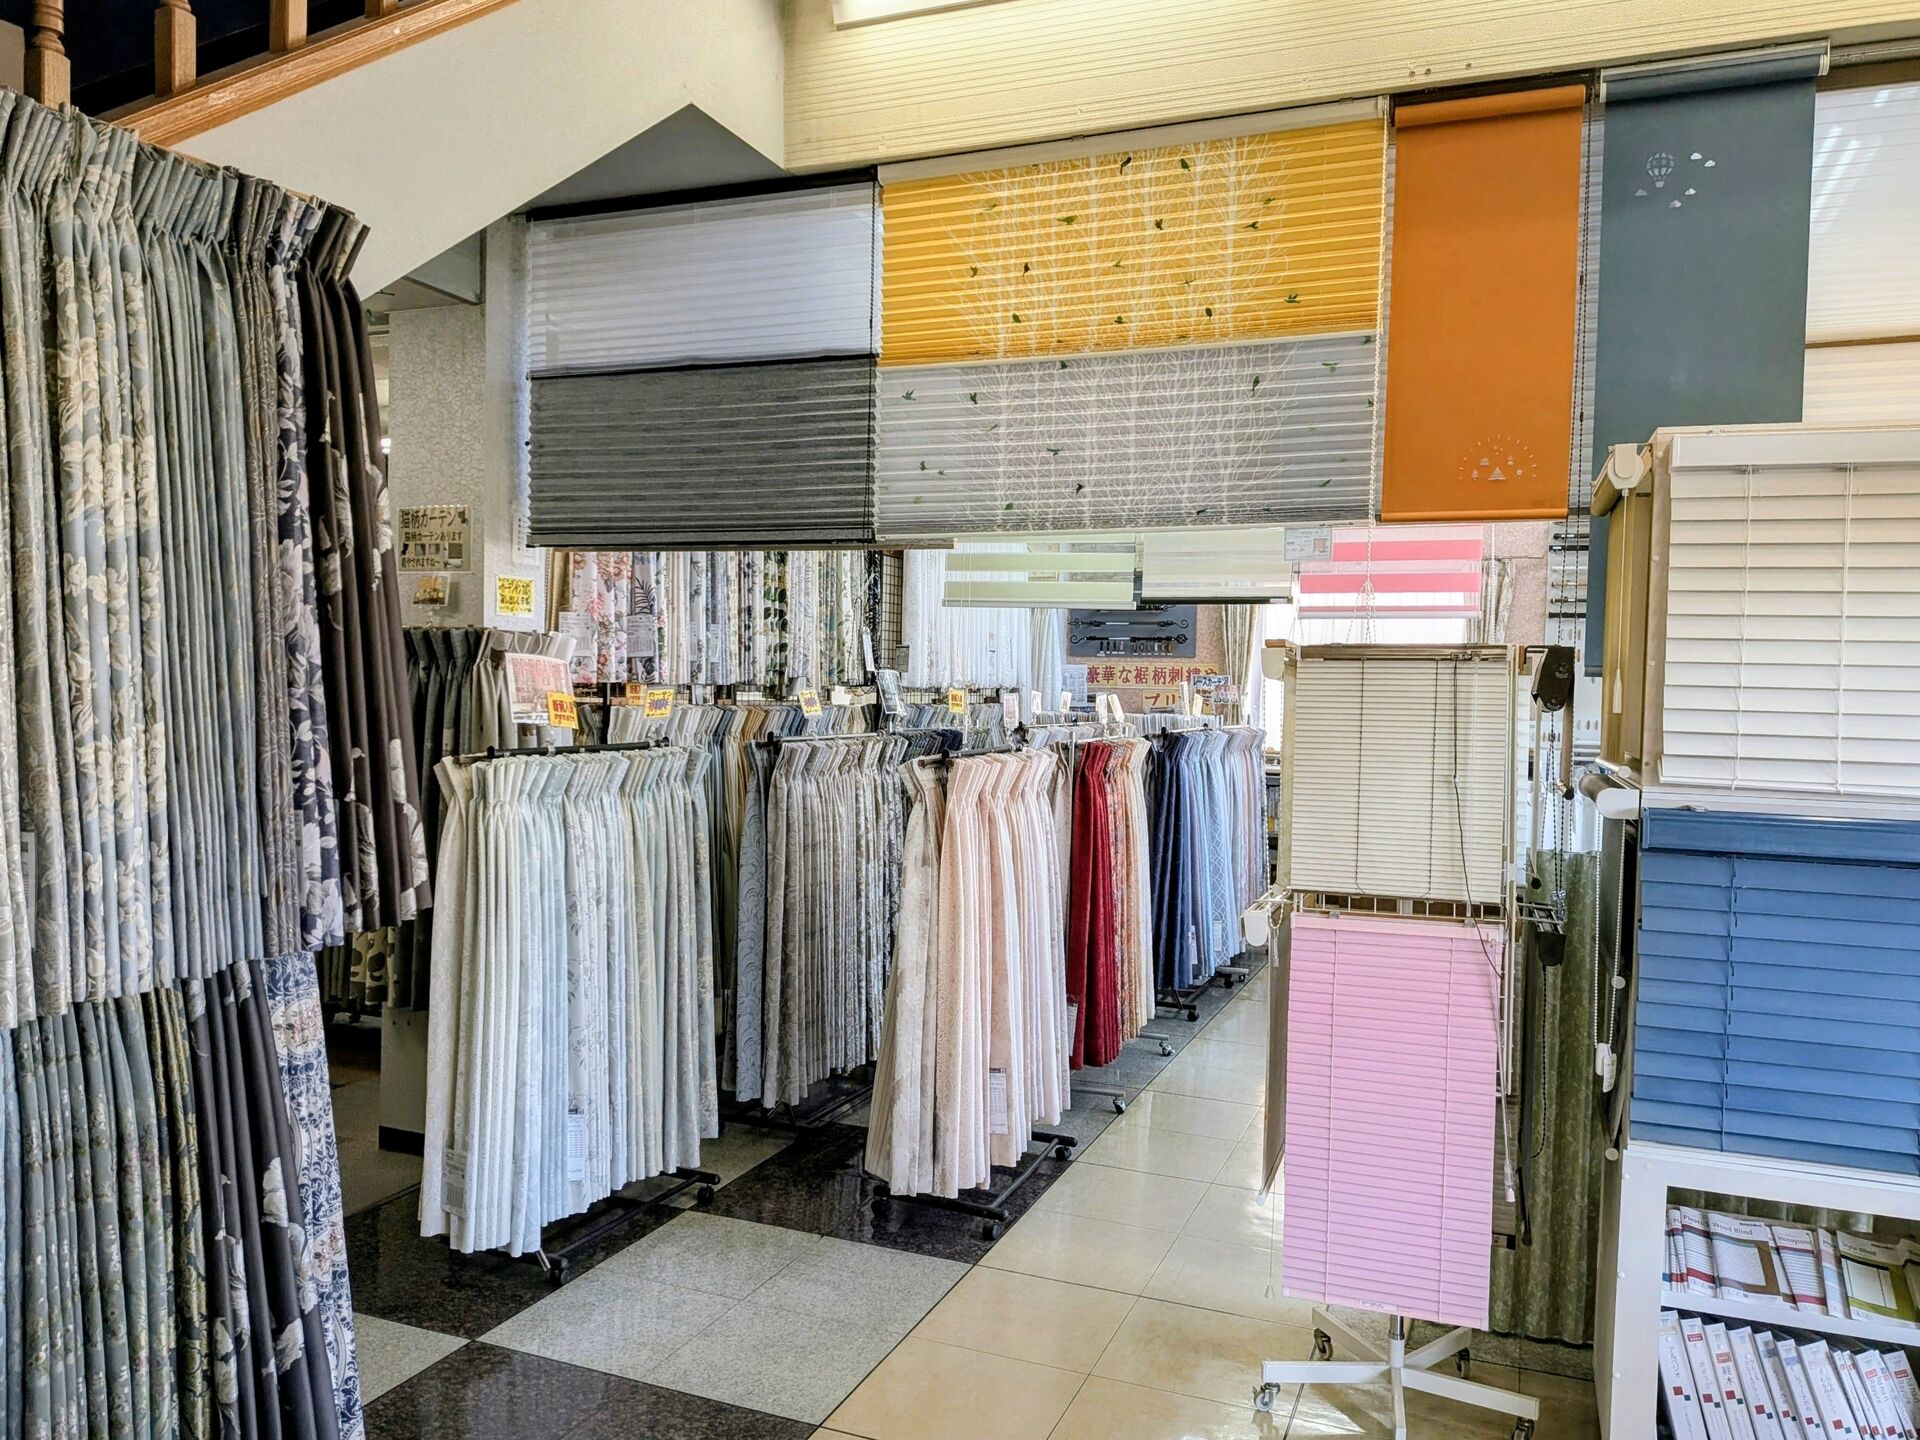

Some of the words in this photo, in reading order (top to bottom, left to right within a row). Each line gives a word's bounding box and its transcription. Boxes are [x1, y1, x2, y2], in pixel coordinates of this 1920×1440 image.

[401, 509, 457, 529] 猫柄カーテン
[1712, 1222, 1732, 1232] Wood
[1733, 1227, 1753, 1235] Blind
